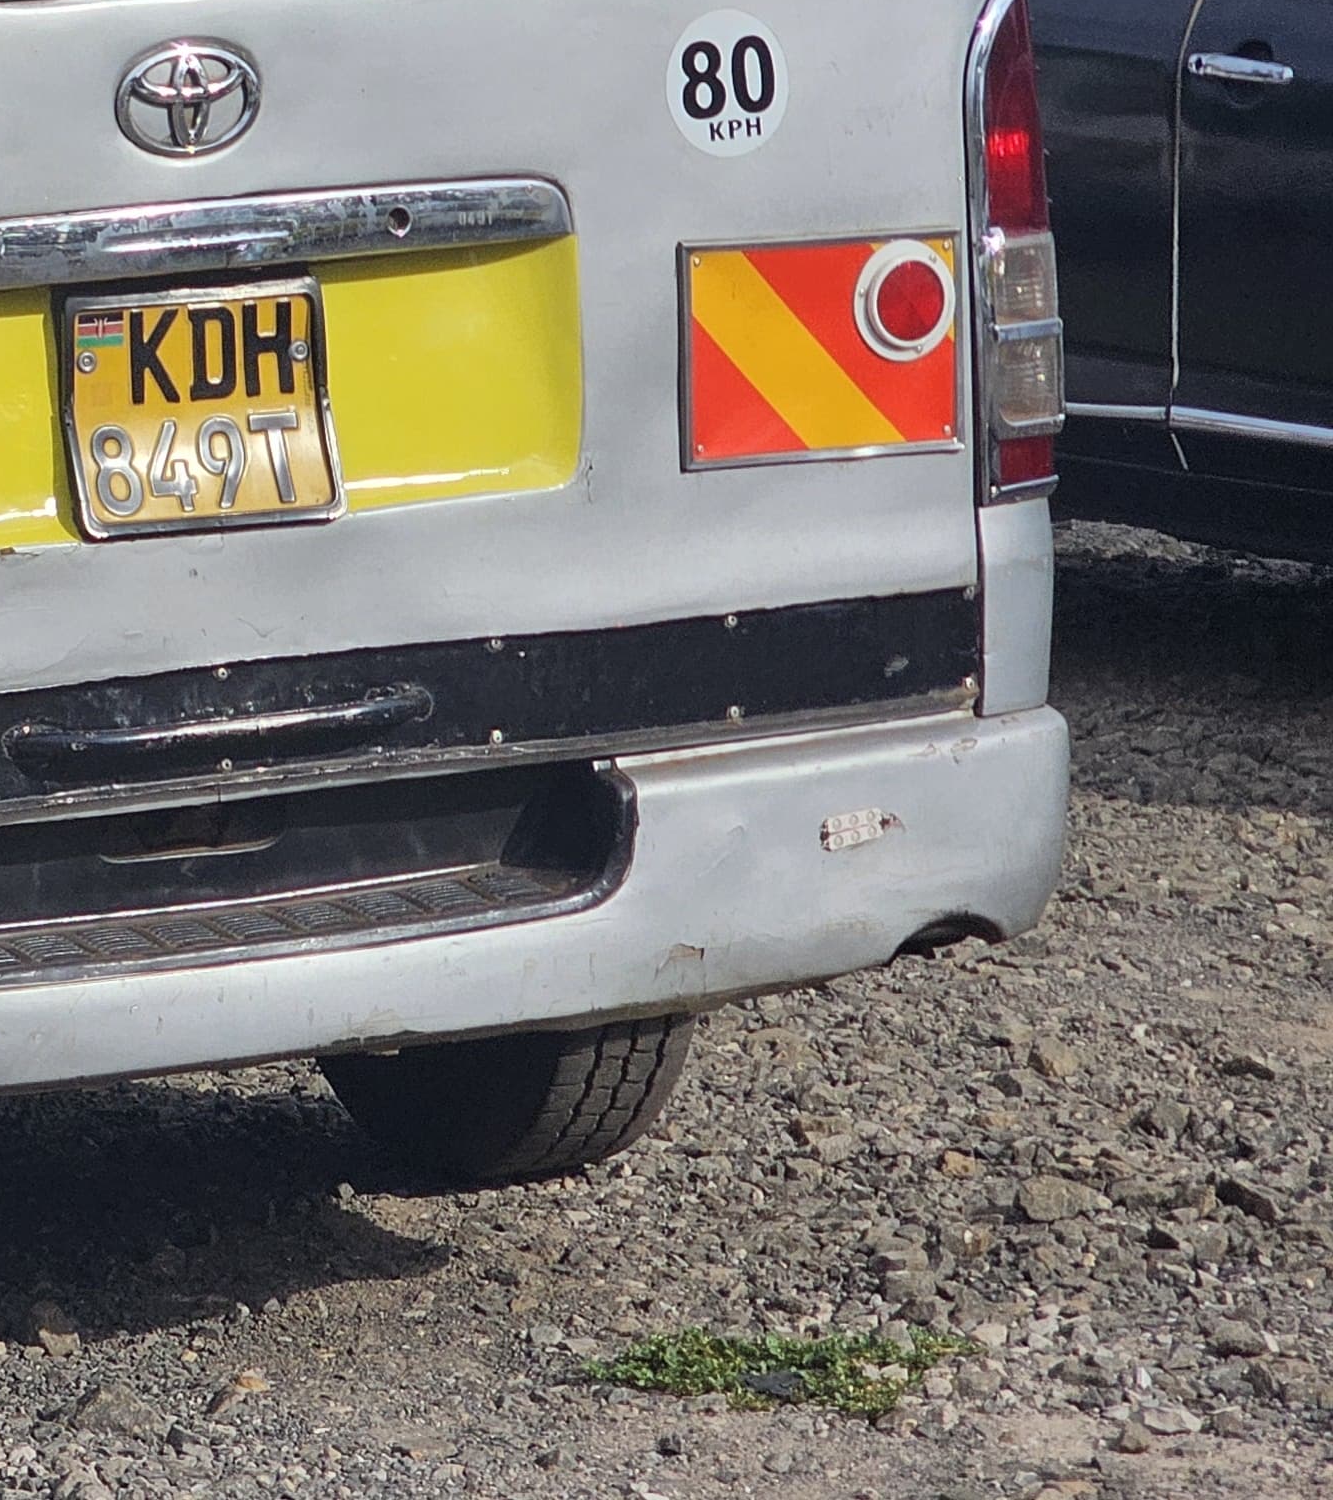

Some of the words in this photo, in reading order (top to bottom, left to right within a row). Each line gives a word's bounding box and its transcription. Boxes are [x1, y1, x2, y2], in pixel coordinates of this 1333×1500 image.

[681, 35, 775, 120] 80
[709, 116, 762, 142] KPH
[129, 299, 295, 405] KDH
[91, 404, 299, 517] 849T
